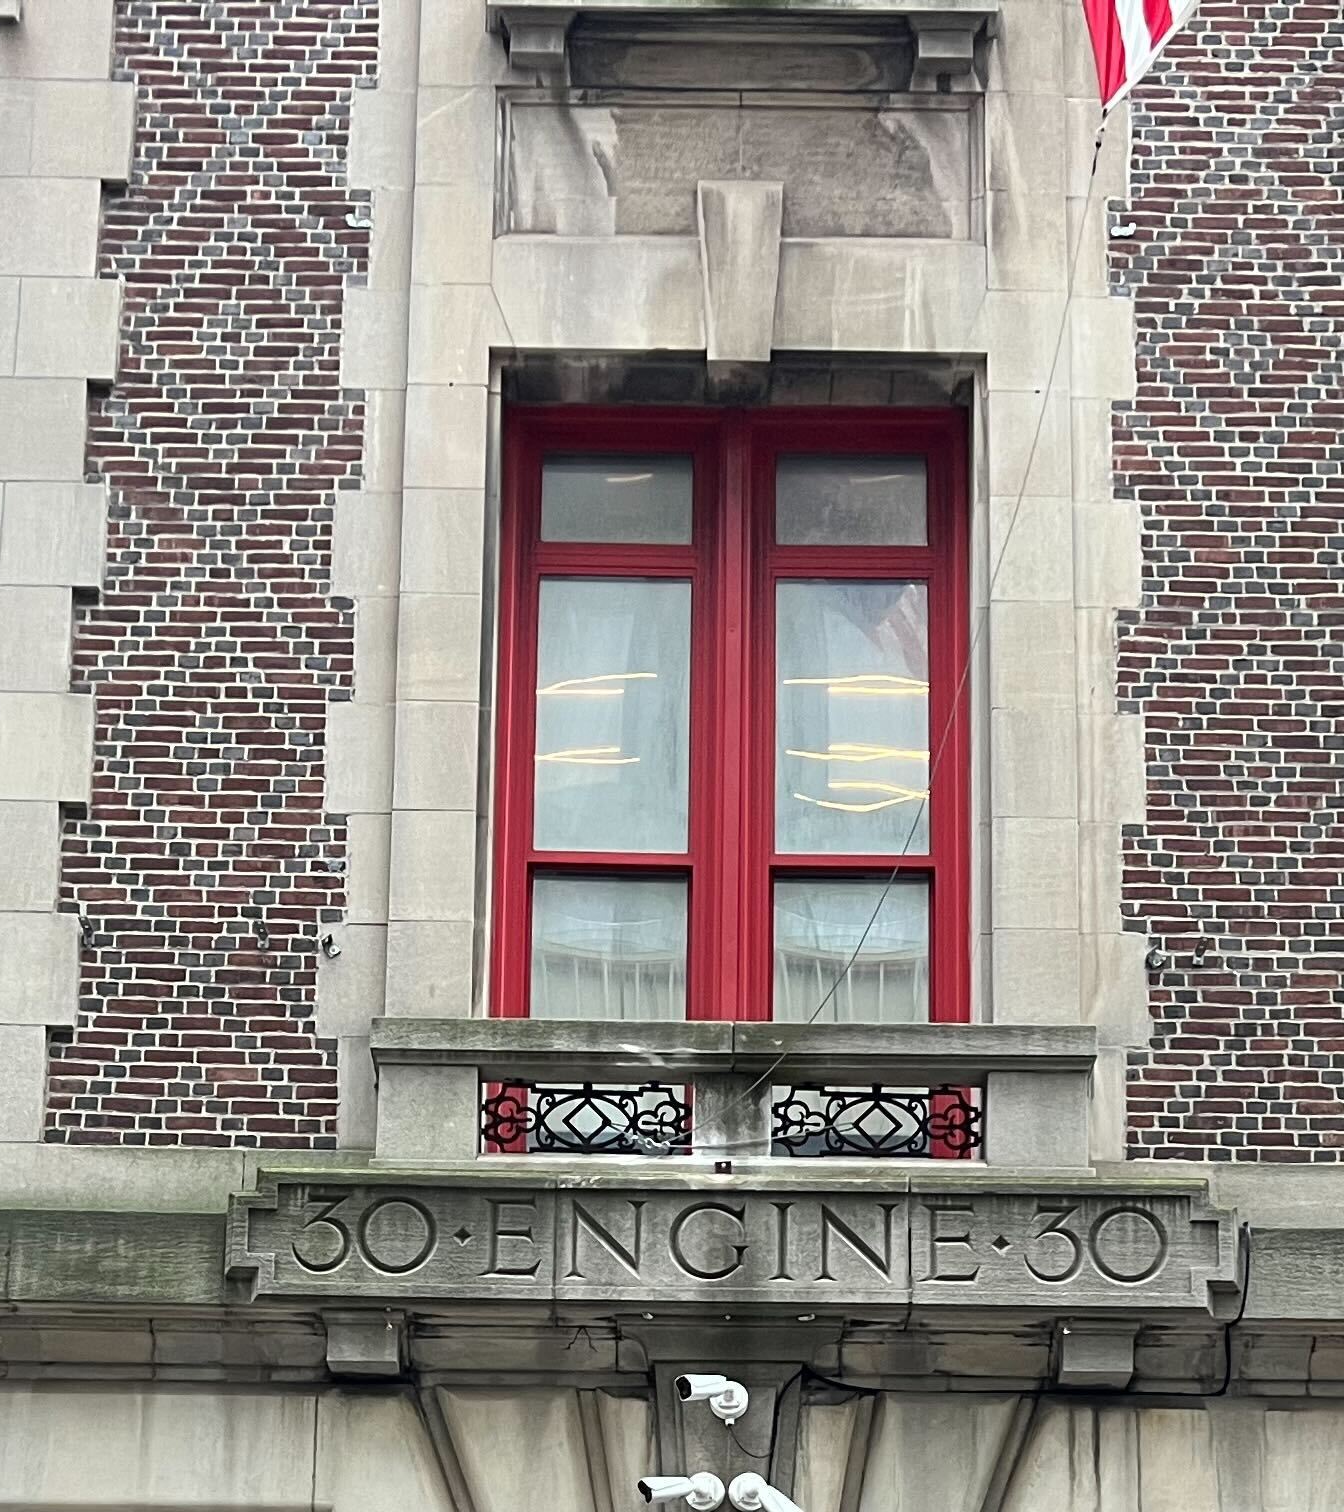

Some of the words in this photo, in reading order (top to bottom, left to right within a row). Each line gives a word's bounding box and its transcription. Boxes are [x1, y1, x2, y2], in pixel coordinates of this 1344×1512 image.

[292, 1194, 438, 1277] 30
[478, 1197, 981, 1285] ENGINE
[1023, 1204, 1169, 1287] 30
